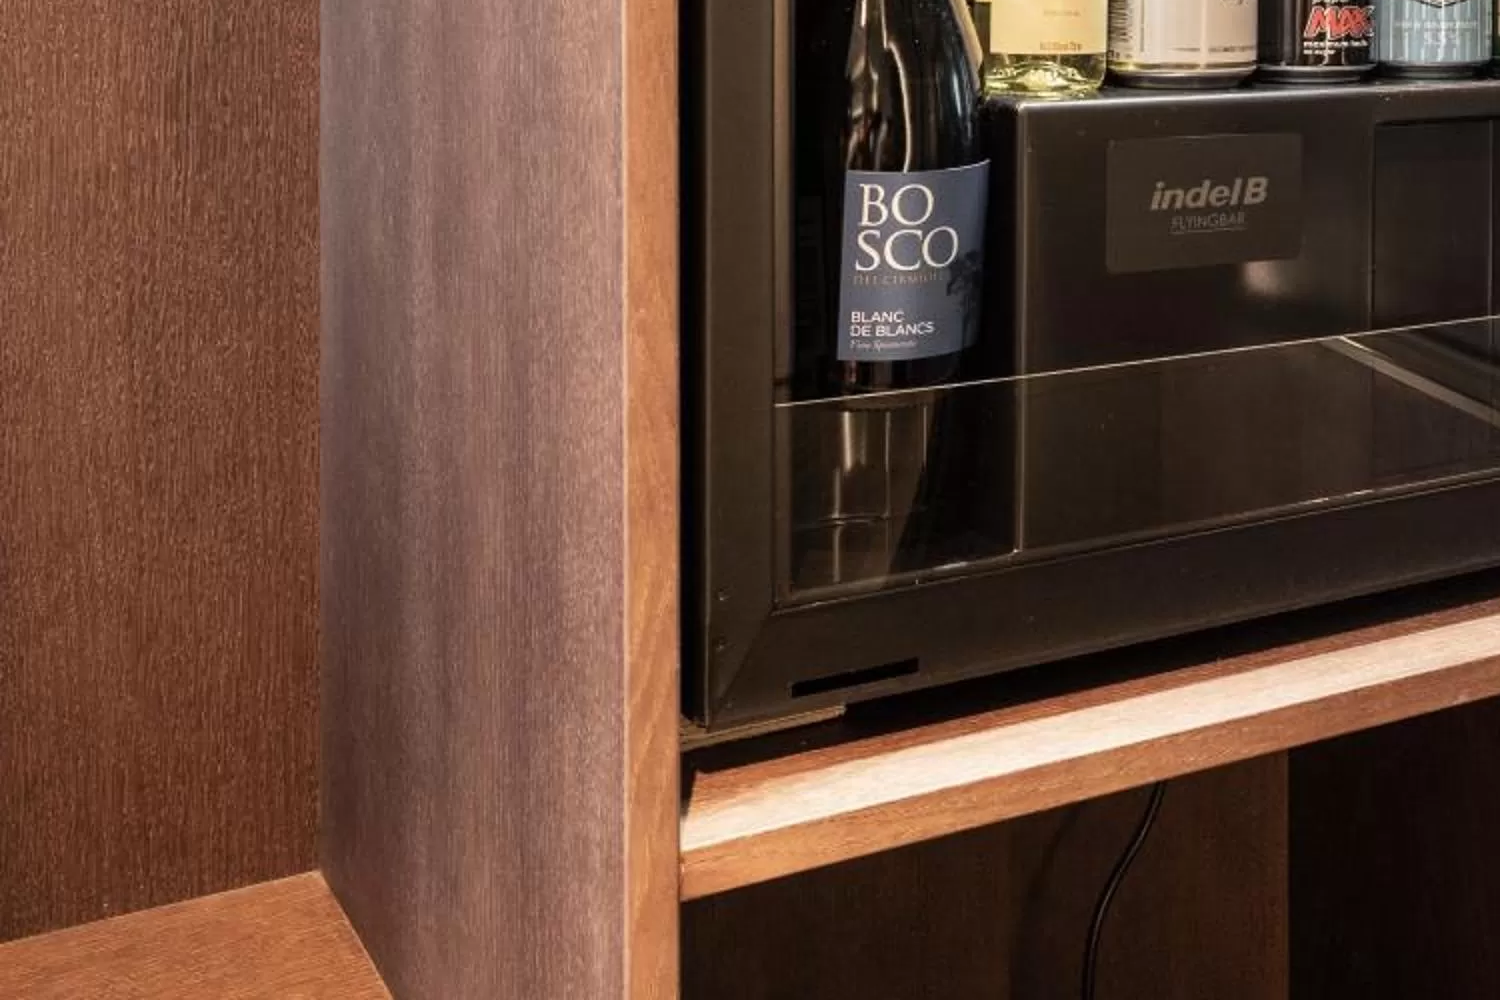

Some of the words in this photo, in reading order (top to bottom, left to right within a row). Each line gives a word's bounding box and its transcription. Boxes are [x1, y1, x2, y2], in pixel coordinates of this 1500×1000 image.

[1304, 5, 1375, 41] MAX
[860, 183, 934, 227] BO
[855, 226, 959, 272] SCO
[850, 325, 872, 337] DE
[875, 321, 935, 337] BLANCS
[851, 311, 904, 323] BLANC
